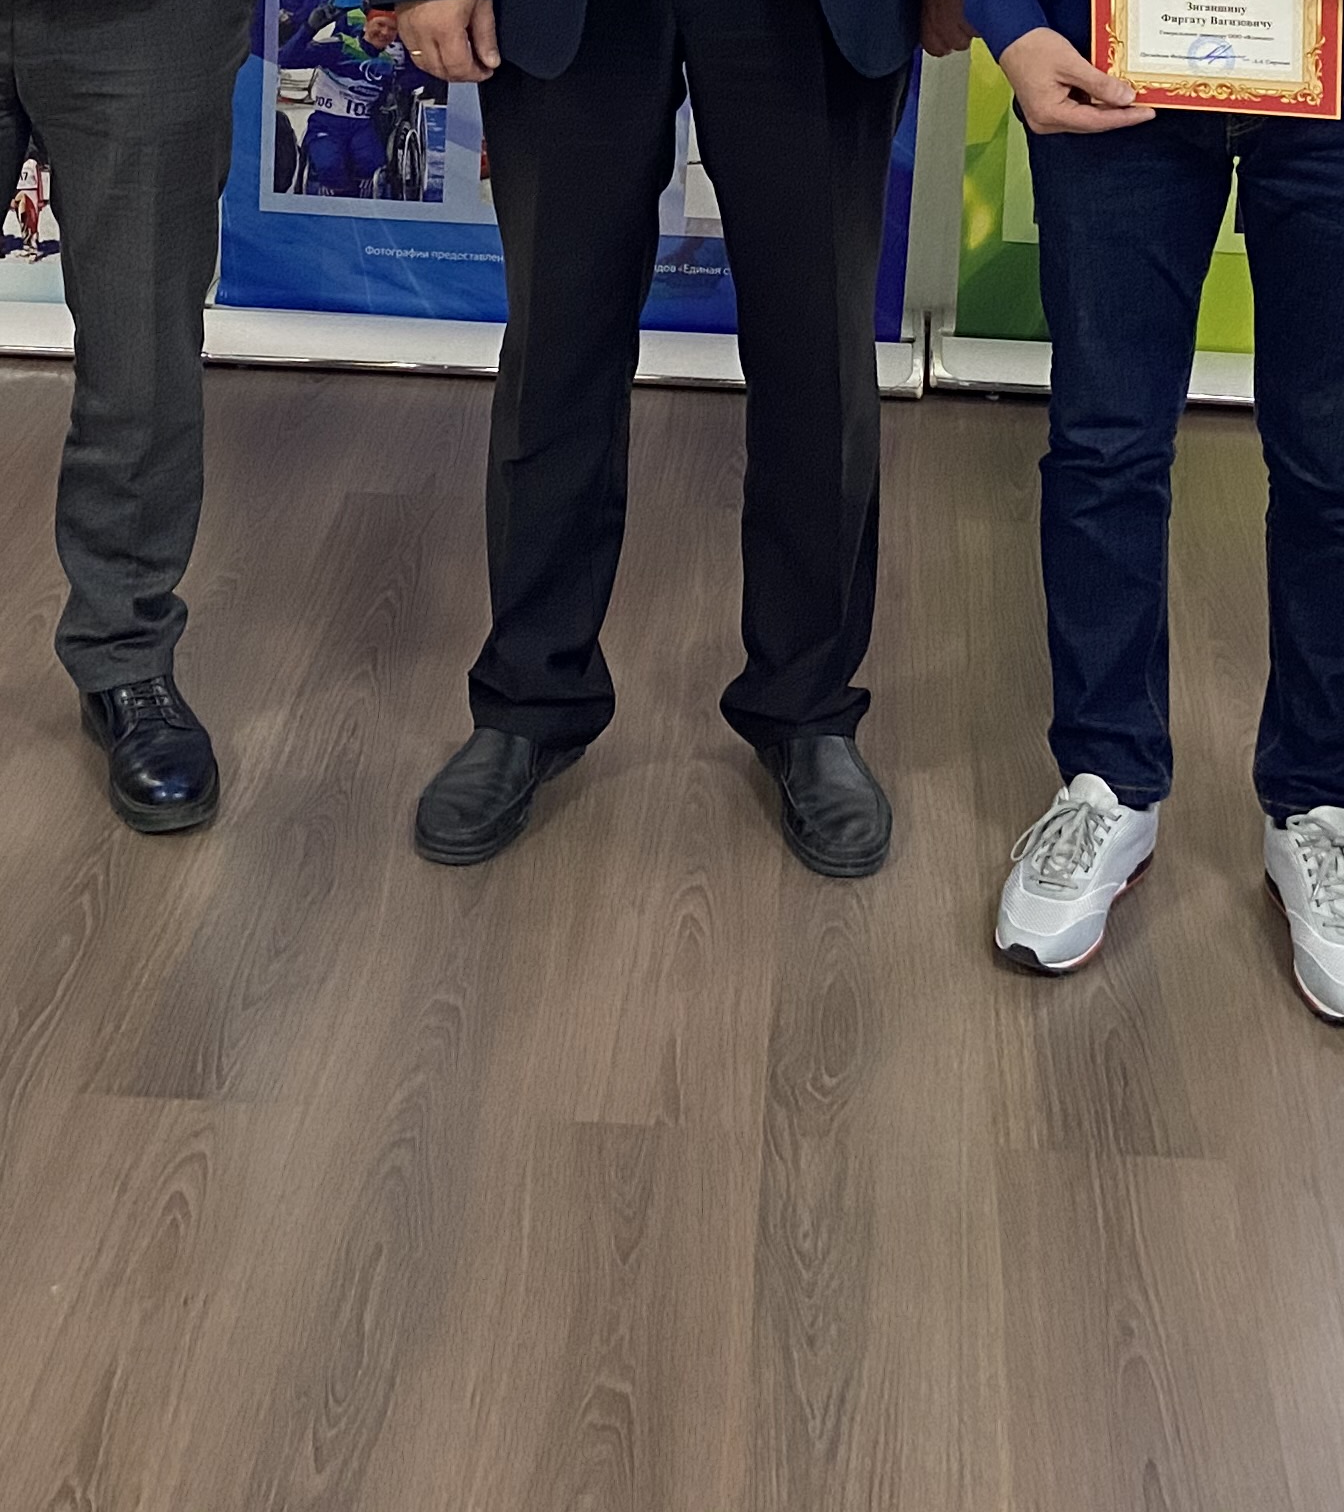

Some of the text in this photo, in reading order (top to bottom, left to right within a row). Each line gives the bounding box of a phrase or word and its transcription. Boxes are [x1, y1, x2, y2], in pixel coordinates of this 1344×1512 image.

[1187, 1, 1247, 16] Зиганшину
[1161, 14, 1273, 29] Фиргату Вагизовичу
[364, 245, 430, 259] Фотографии
